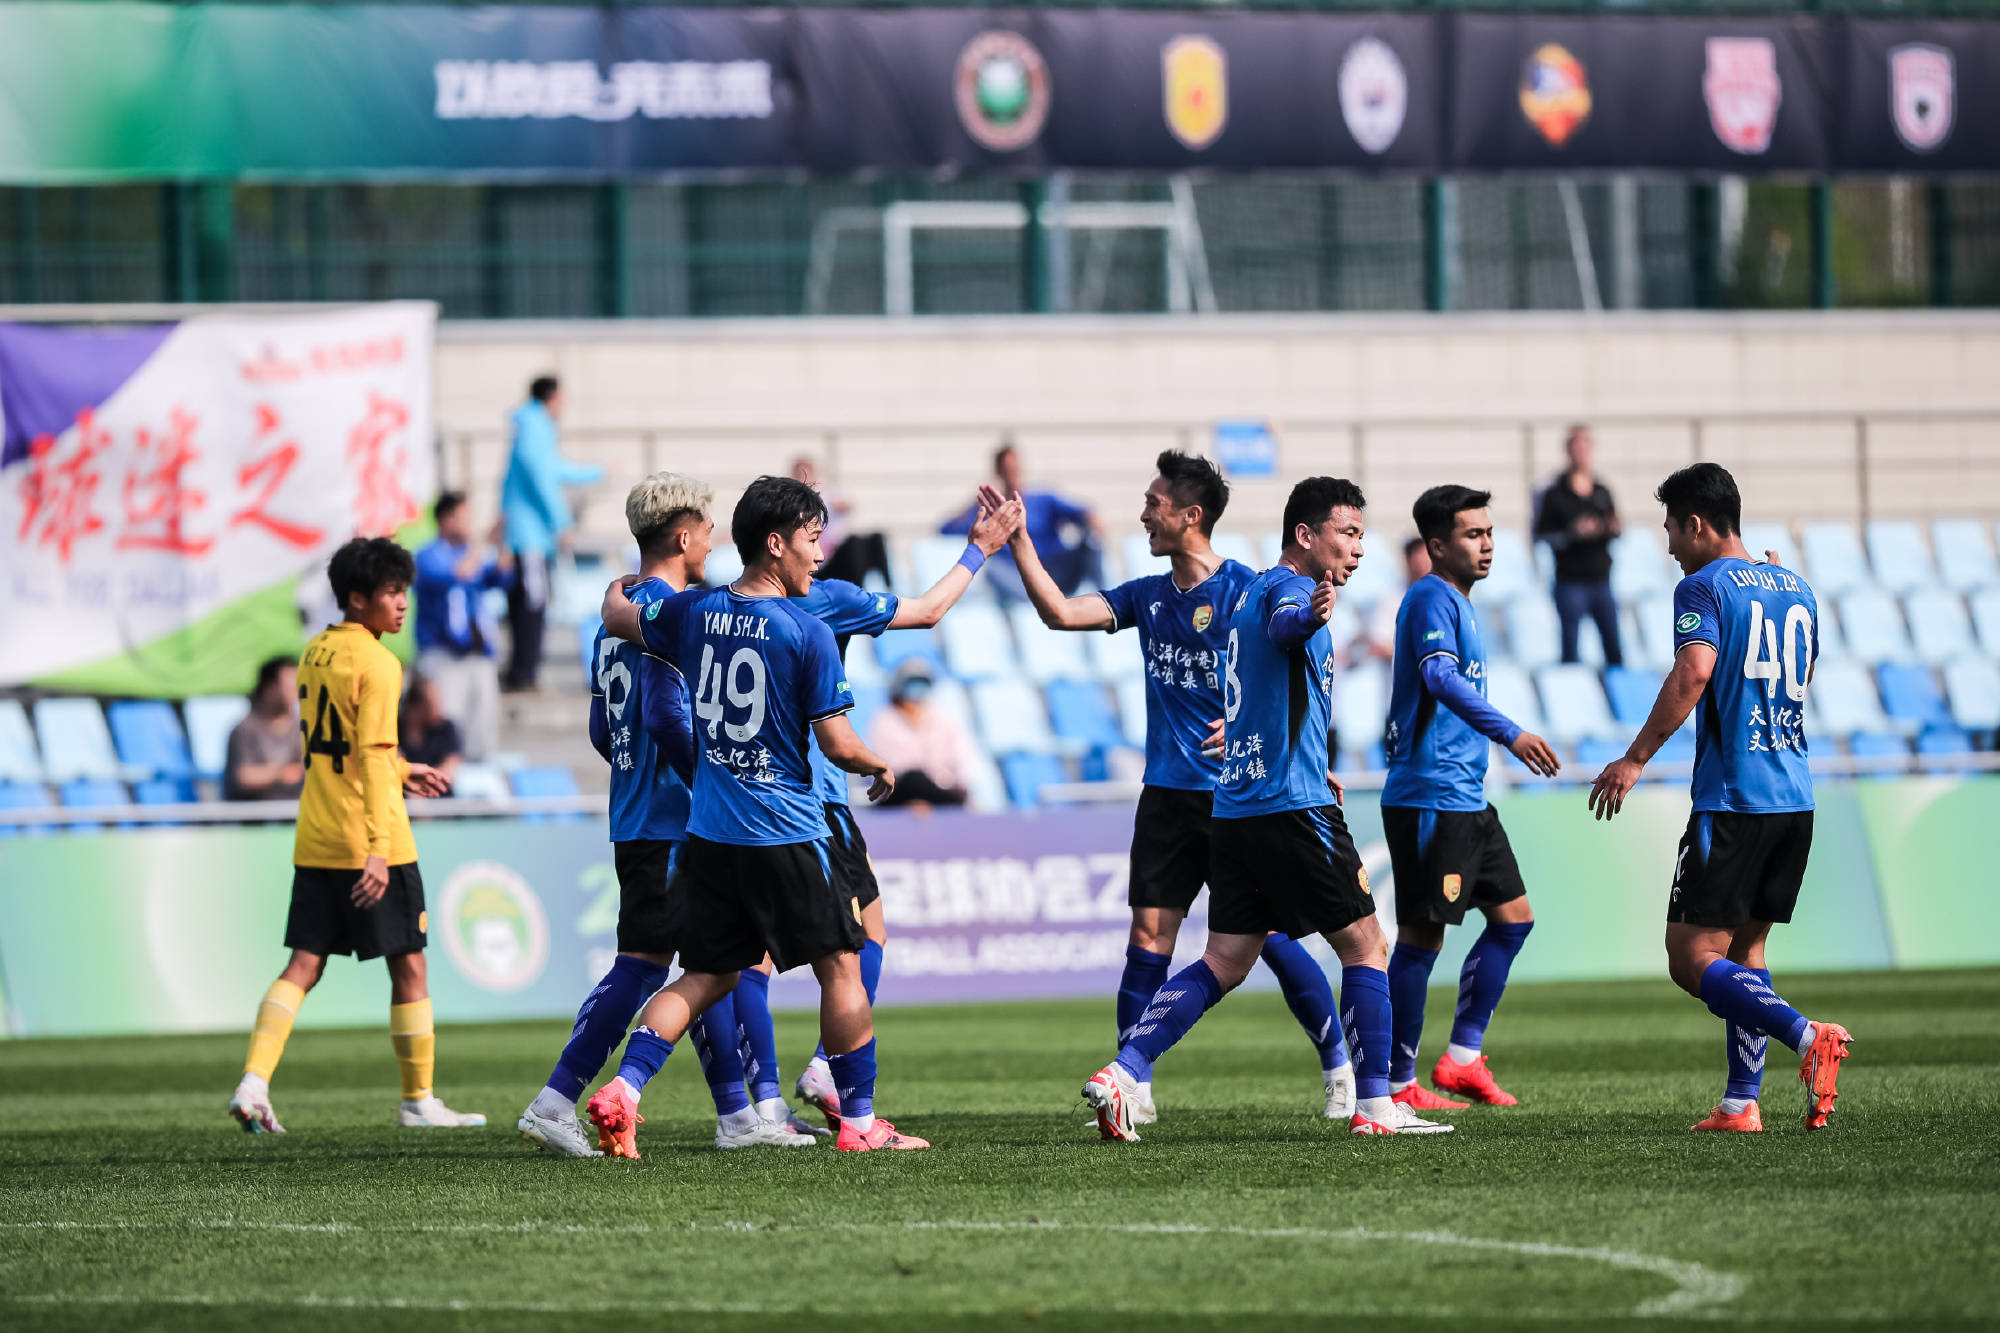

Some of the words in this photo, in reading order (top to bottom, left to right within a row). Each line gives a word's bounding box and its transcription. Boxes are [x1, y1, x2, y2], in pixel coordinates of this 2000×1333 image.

[18, 392, 418, 566] 球迷之家
[705, 611, 733, 635] YAN
[733, 615, 770, 640] SH.K.
[1728, 569, 1758, 587] LIU
[696, 643, 766, 743] 49
[1744, 600, 1813, 702] 40
